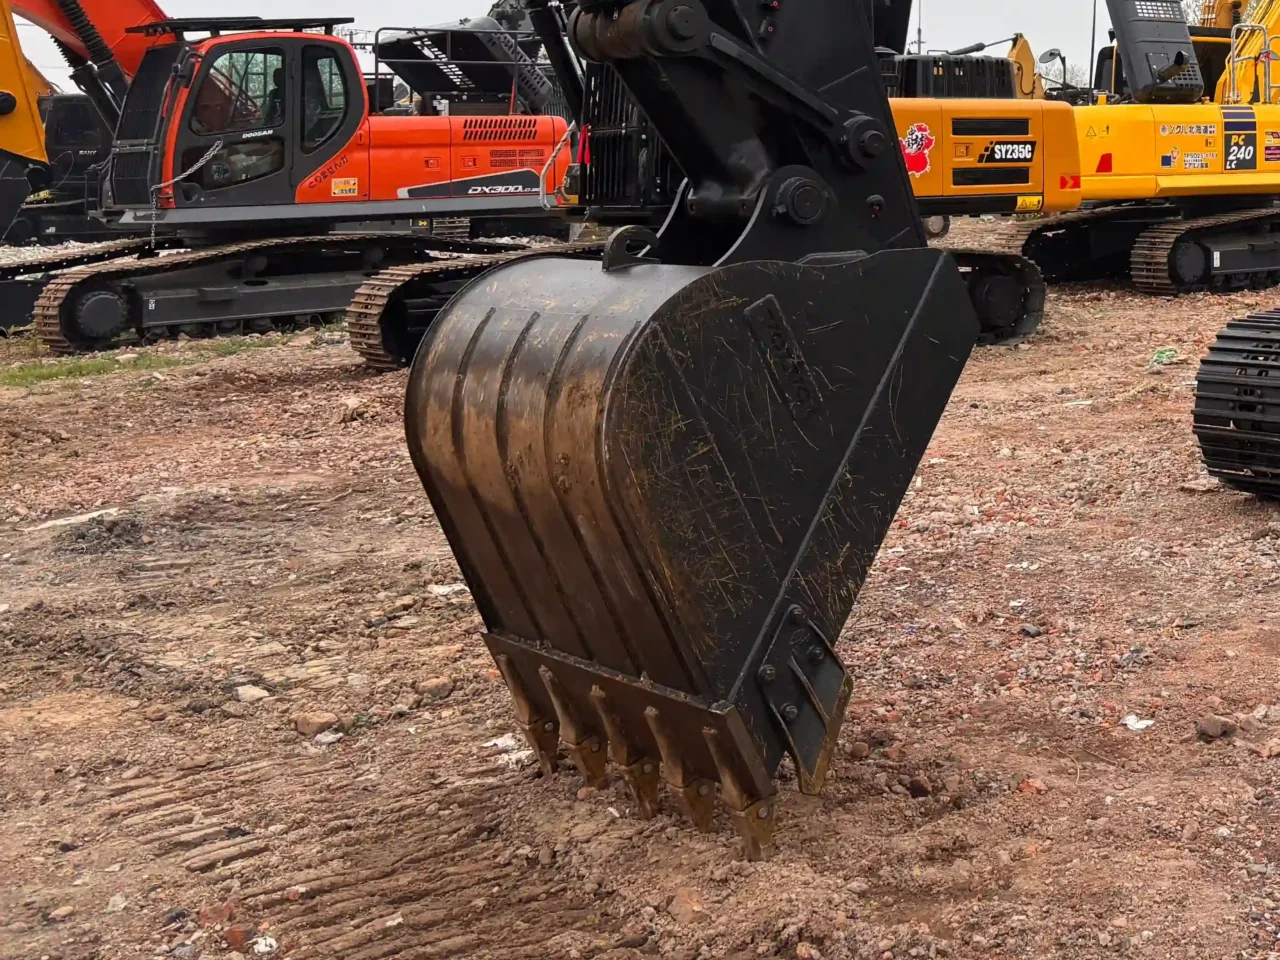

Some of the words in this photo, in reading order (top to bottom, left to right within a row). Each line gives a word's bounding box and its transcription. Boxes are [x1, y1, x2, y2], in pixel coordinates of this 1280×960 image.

[242, 129, 274, 139] DOOSAN
[1230, 135, 1245, 145] PC
[994, 144, 1032, 159] SY235C
[1227, 146, 1253, 160] 240
[1225, 161, 1237, 169] LC
